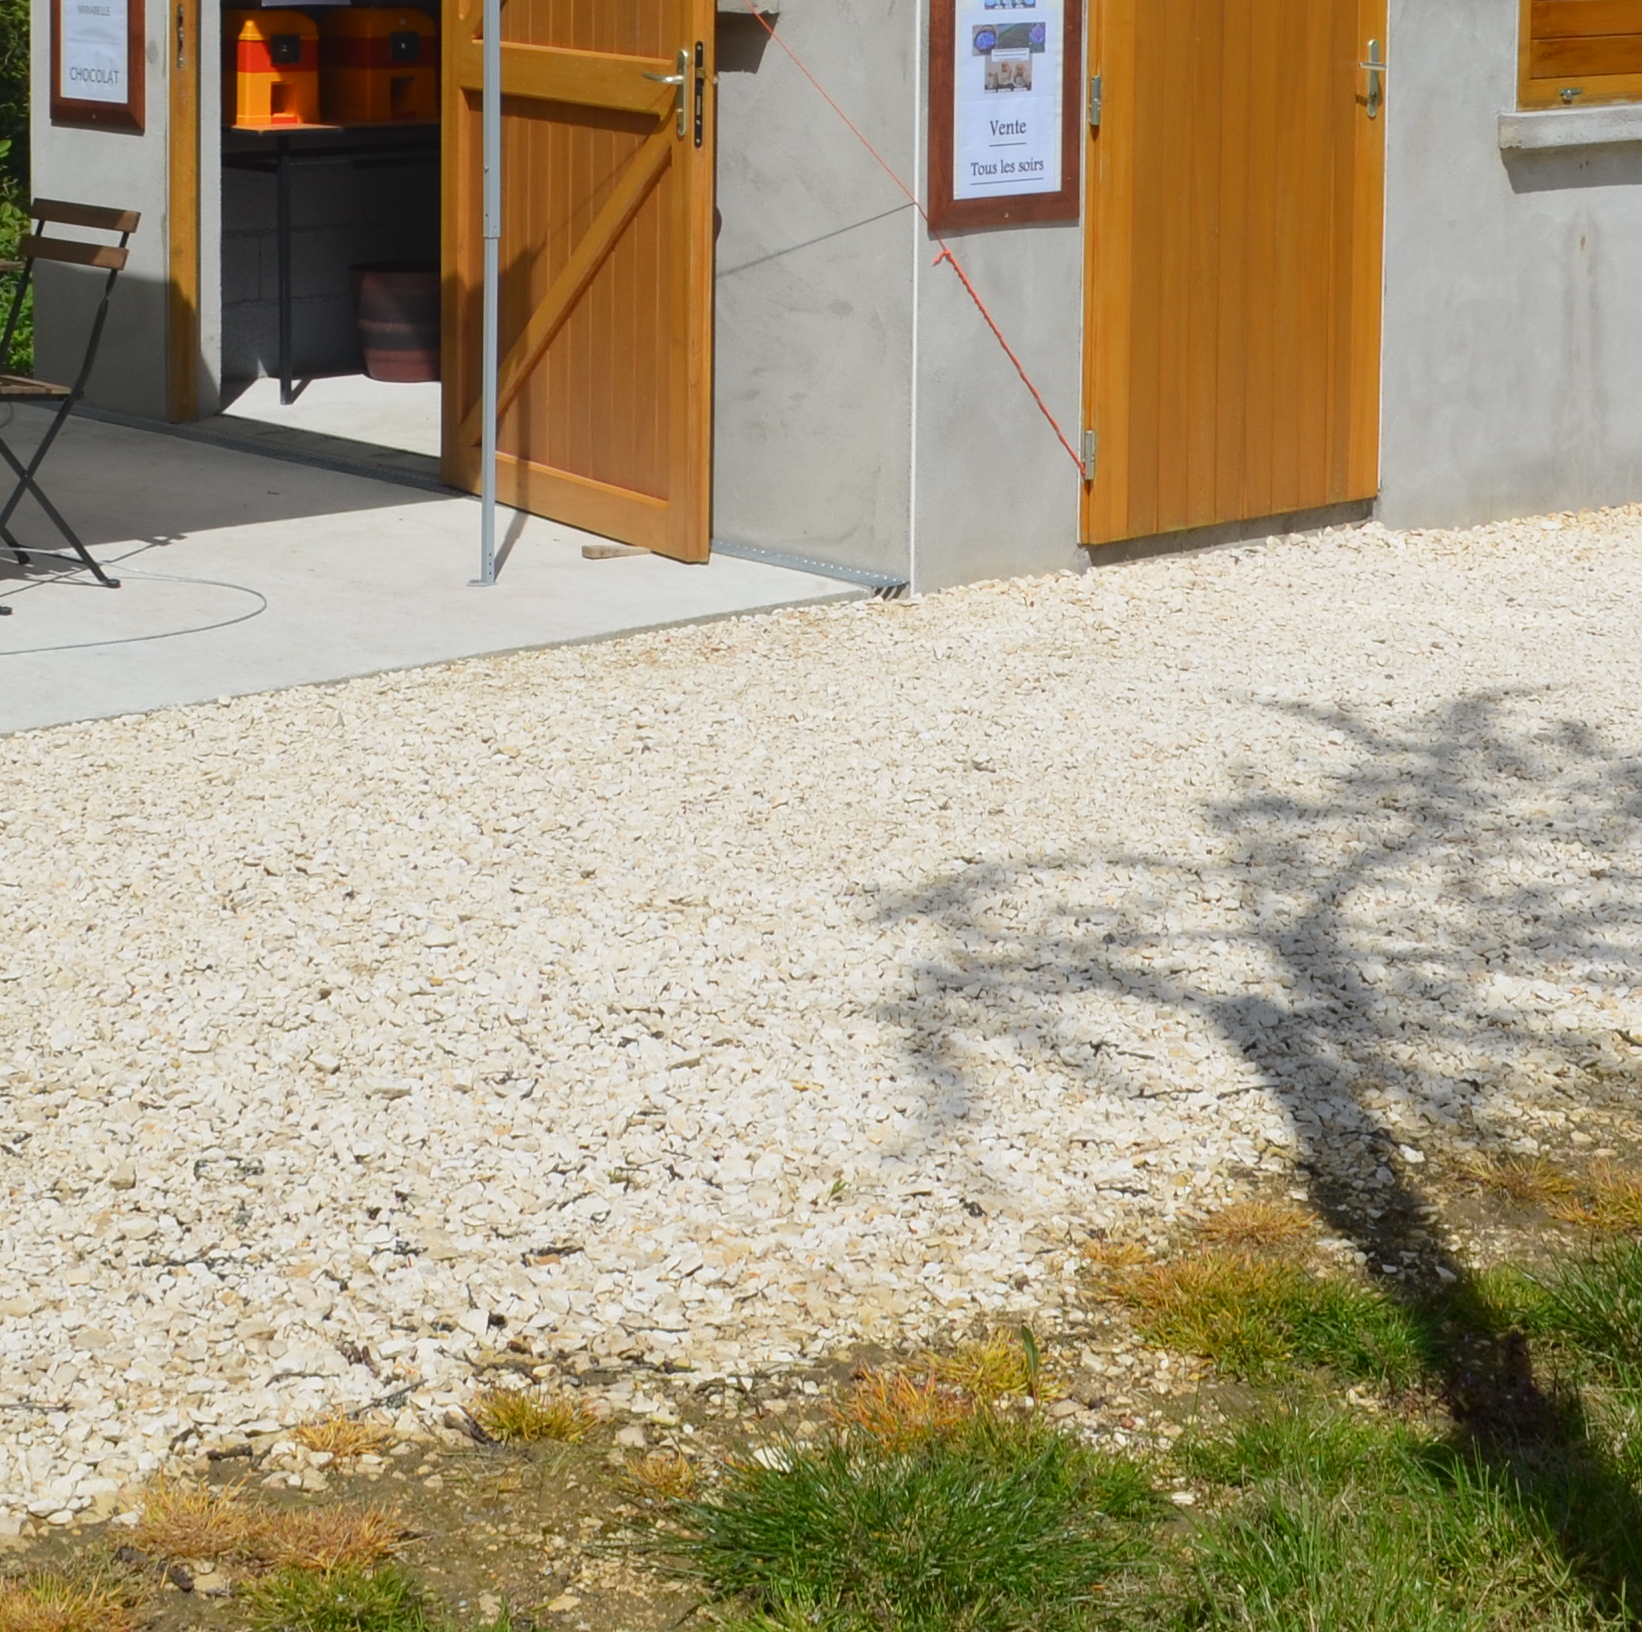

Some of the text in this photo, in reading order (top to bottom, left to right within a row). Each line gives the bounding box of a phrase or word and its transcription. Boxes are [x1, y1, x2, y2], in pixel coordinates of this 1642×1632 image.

[69, 67, 119, 84] CHOCOLAT
[989, 120, 1027, 136] Vente
[970, 157, 1044, 176] Tous les soirs
